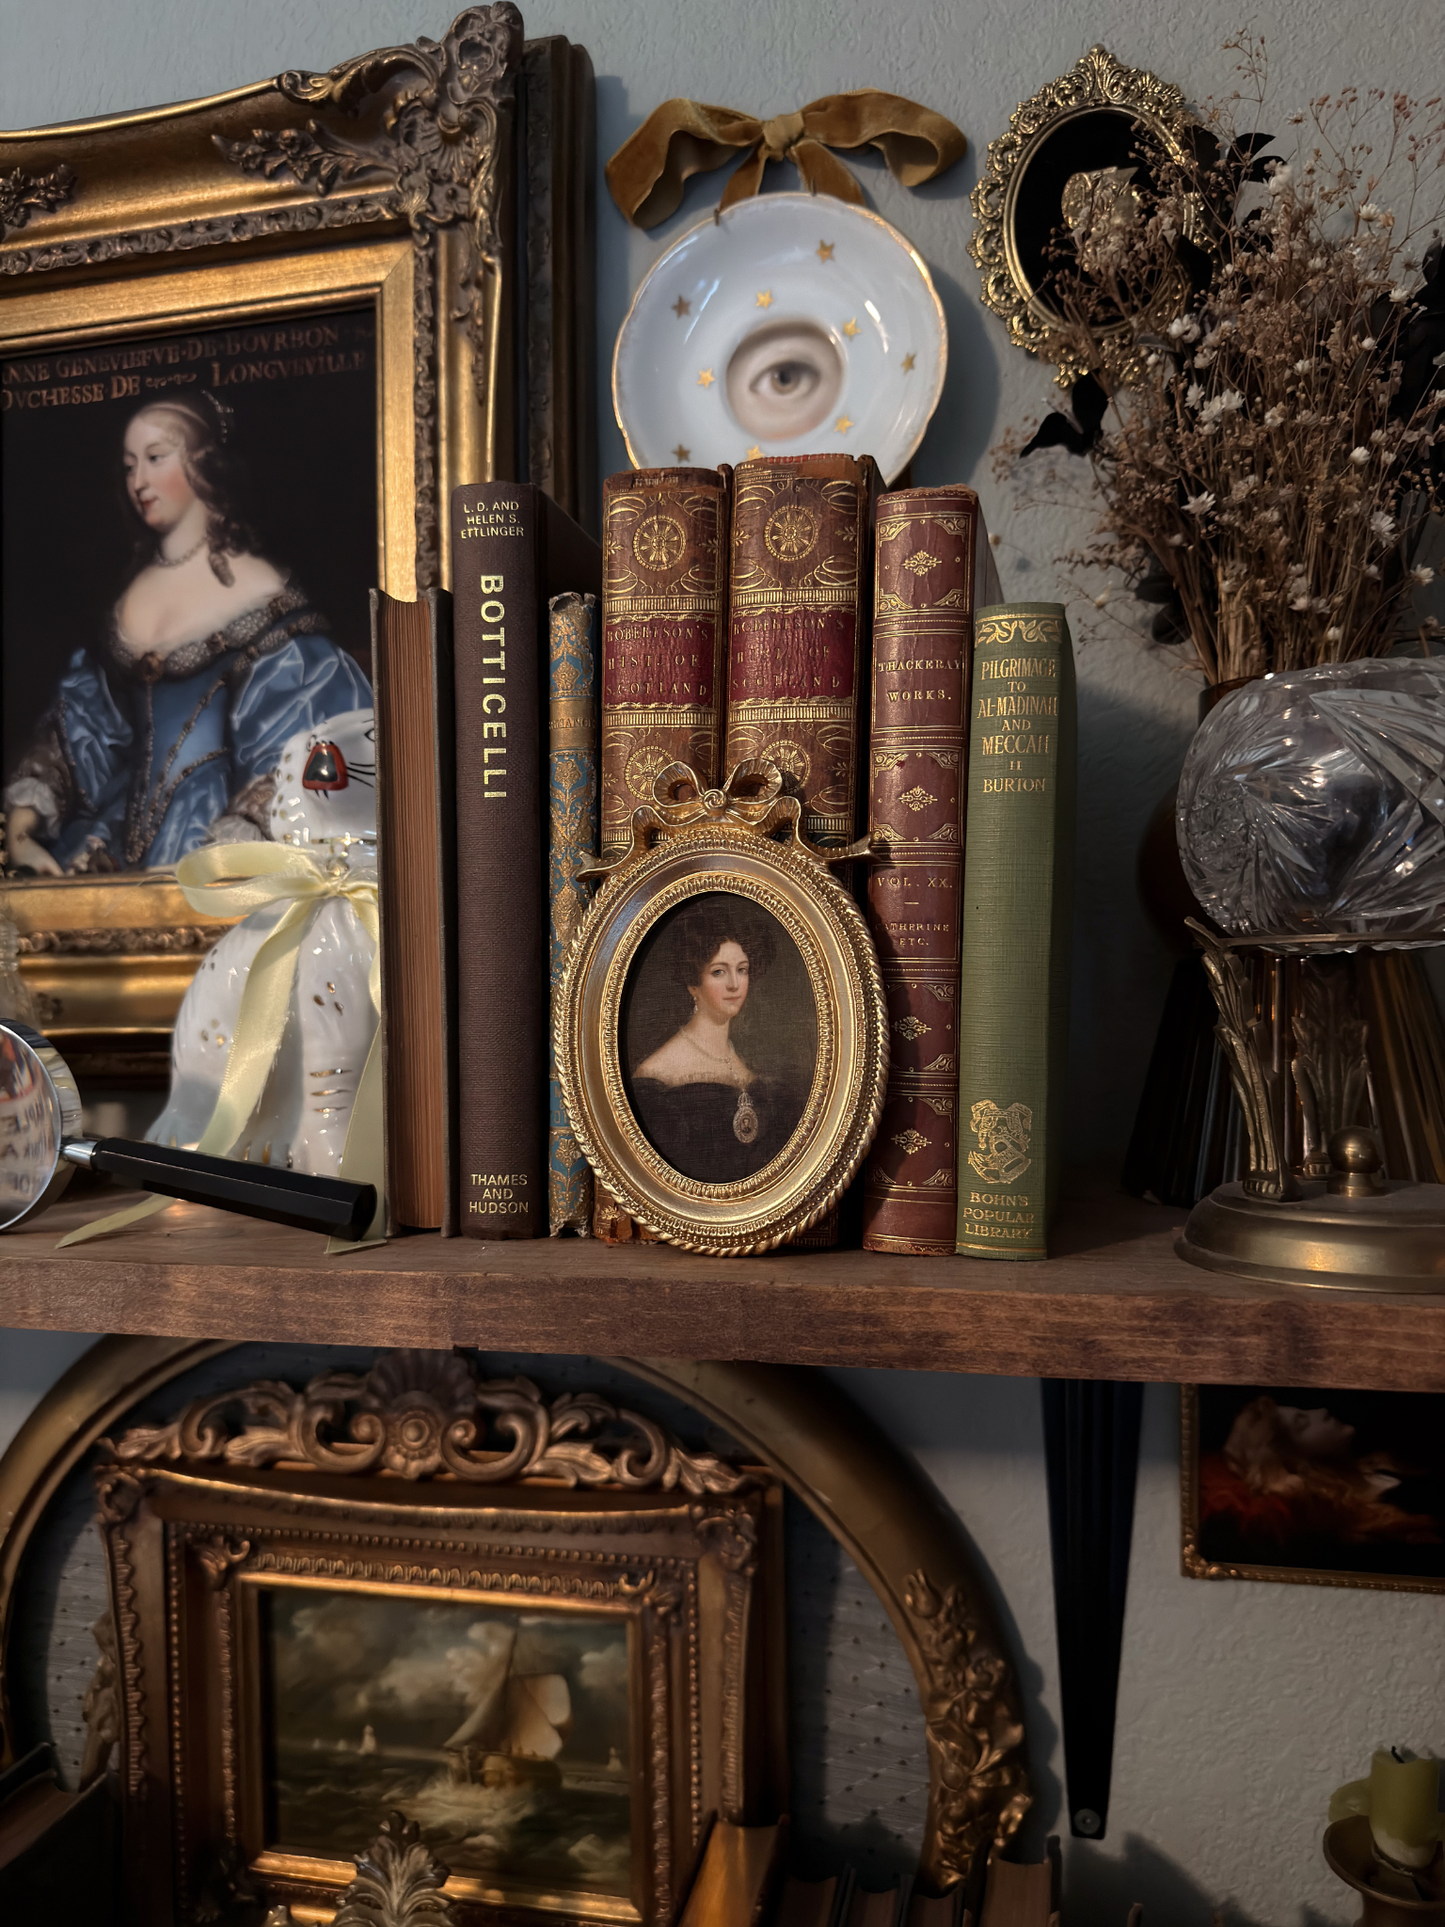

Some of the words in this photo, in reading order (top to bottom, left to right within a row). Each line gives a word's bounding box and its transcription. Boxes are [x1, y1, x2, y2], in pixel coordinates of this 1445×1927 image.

[110, 374, 142, 399] DE
[463, 503, 474, 514] L.
[477, 502, 489, 512] D.
[492, 501, 520, 511] AND
[466, 513, 504, 525] HELEN
[509, 513, 520, 524] S.
[460, 526, 525, 539] ETTLINGER
[981, 657, 1056, 680] PILGRIMAGE
[480, 575, 507, 799] BOTTICELLI
[606, 681, 707, 696] SCOTLAND
[1007, 681, 1026, 692] TO
[887, 689, 952, 702] WORKS.
[977, 696, 1058, 718] AL-MADINAH
[1001, 719, 1031, 731] AND
[982, 734, 1049, 755] MECCAH
[982, 777, 1046, 793] BURTON
[877, 877, 920, 887] VOL.
[927, 877, 953, 888] XX.
[899, 937, 929, 948] ETC.
[470, 1173, 528, 1186] THAMES
[482, 1188, 514, 1199] AND
[969, 1191, 1028, 1207] BOHN'S
[469, 1201, 529, 1214] HUDSON
[962, 1207, 1035, 1223] POPULAR
[964, 1222, 1033, 1239] LIBRARY
